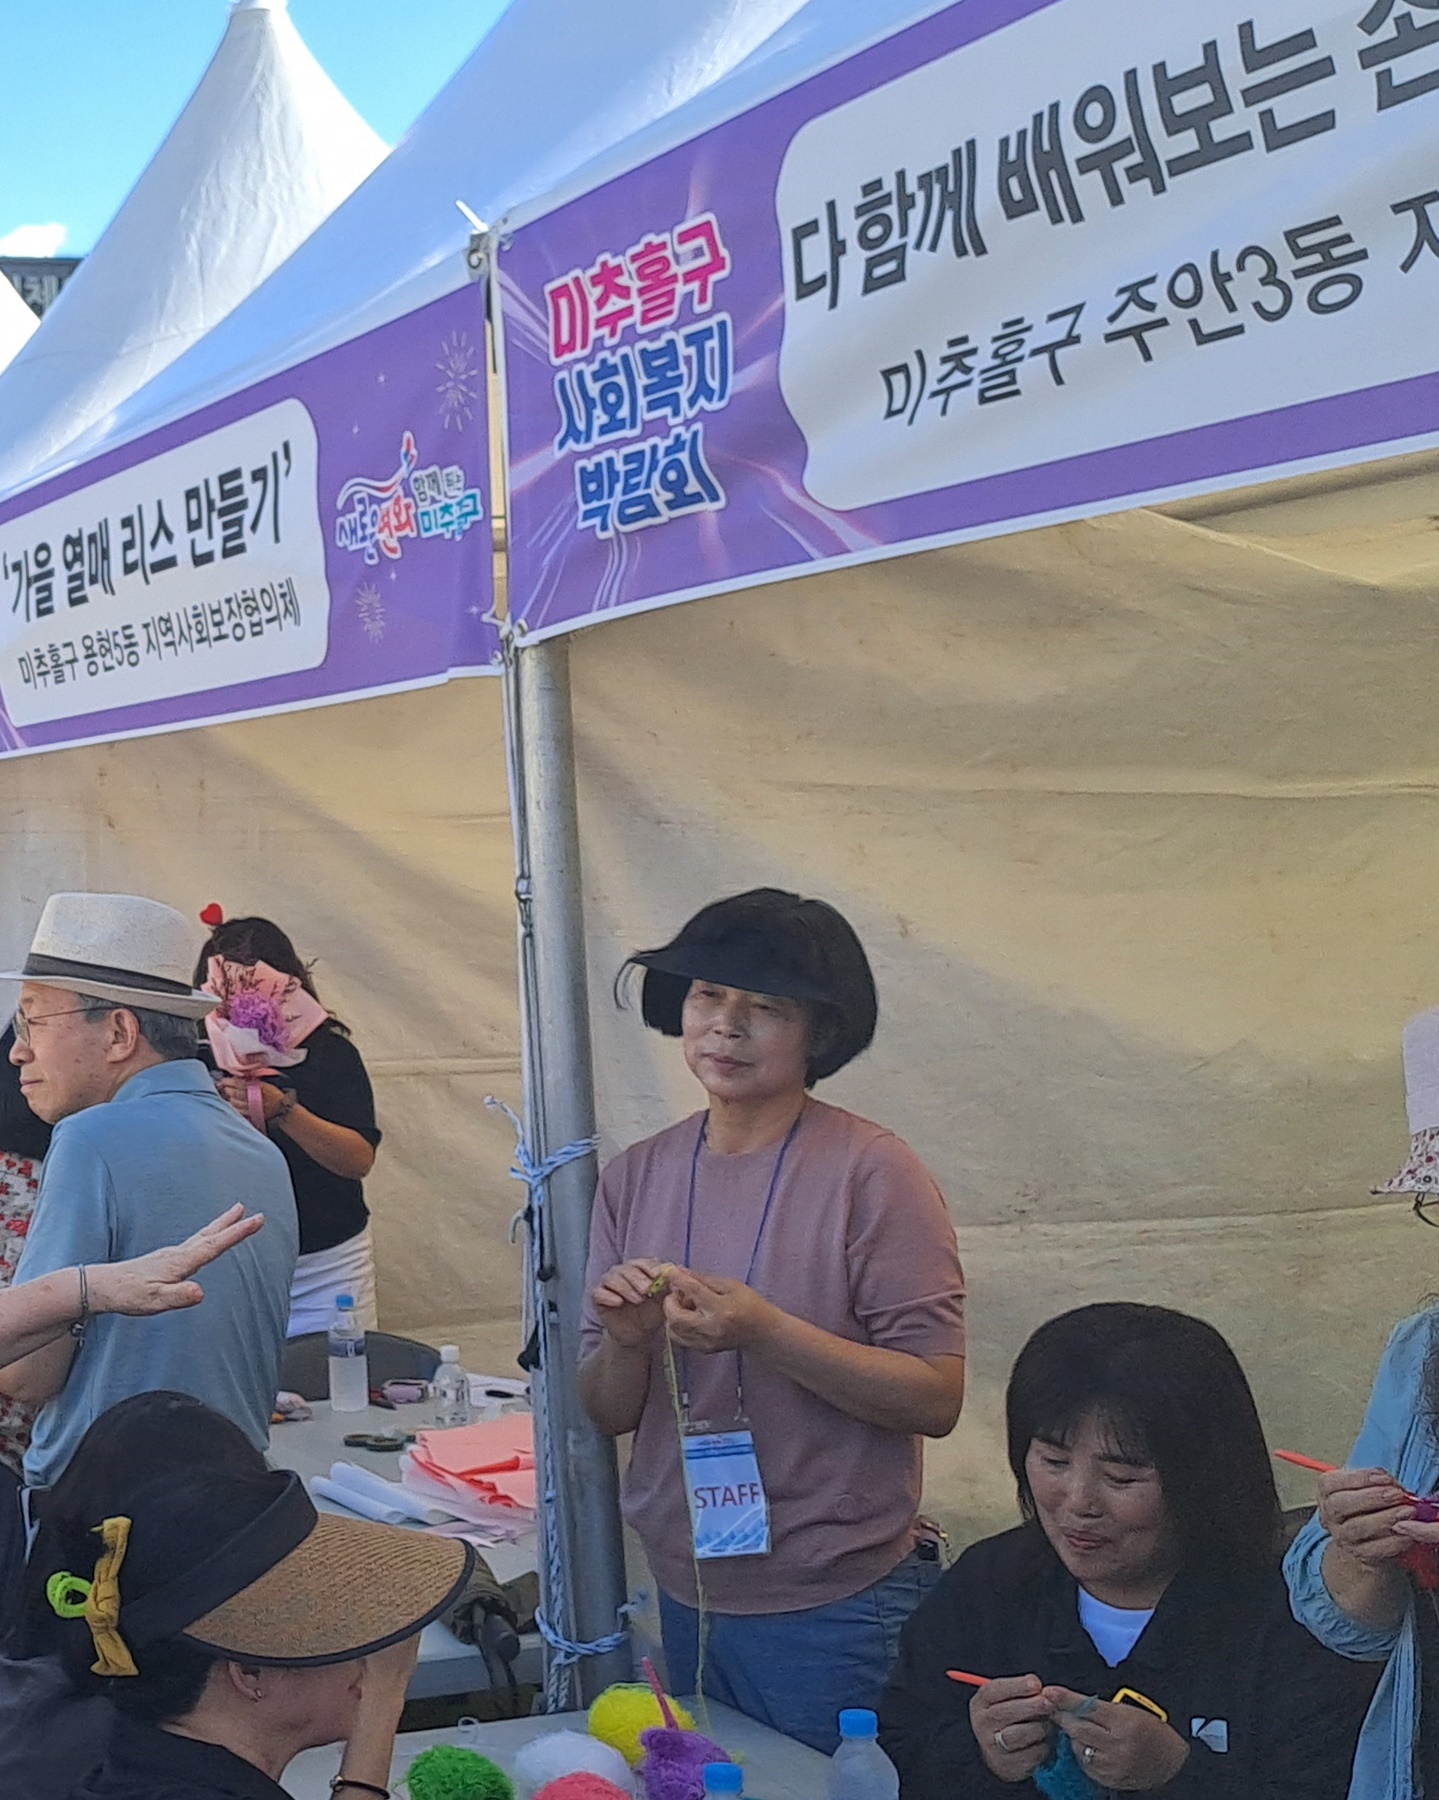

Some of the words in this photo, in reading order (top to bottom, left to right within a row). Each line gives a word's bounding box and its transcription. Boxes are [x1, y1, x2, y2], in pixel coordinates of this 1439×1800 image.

[791, 138, 988, 312] 다함께
[997, 19, 1336, 227] 배워보는
[549, 219, 727, 359] 미추홀구
[880, 300, 1086, 427] 미추홀구
[1103, 213, 1369, 363] 주안3동
[557, 319, 728, 451] 사회복지
[578, 429, 721, 533] 박람회
[62, 516, 116, 609] 열매
[120, 498, 178, 586] 리스
[18, 640, 79, 690] 미추홀구
[81, 623, 140, 677] 용현5동
[142, 576, 301, 661] 지역사회보장협의체
[693, 1482, 760, 1509] STAFF
